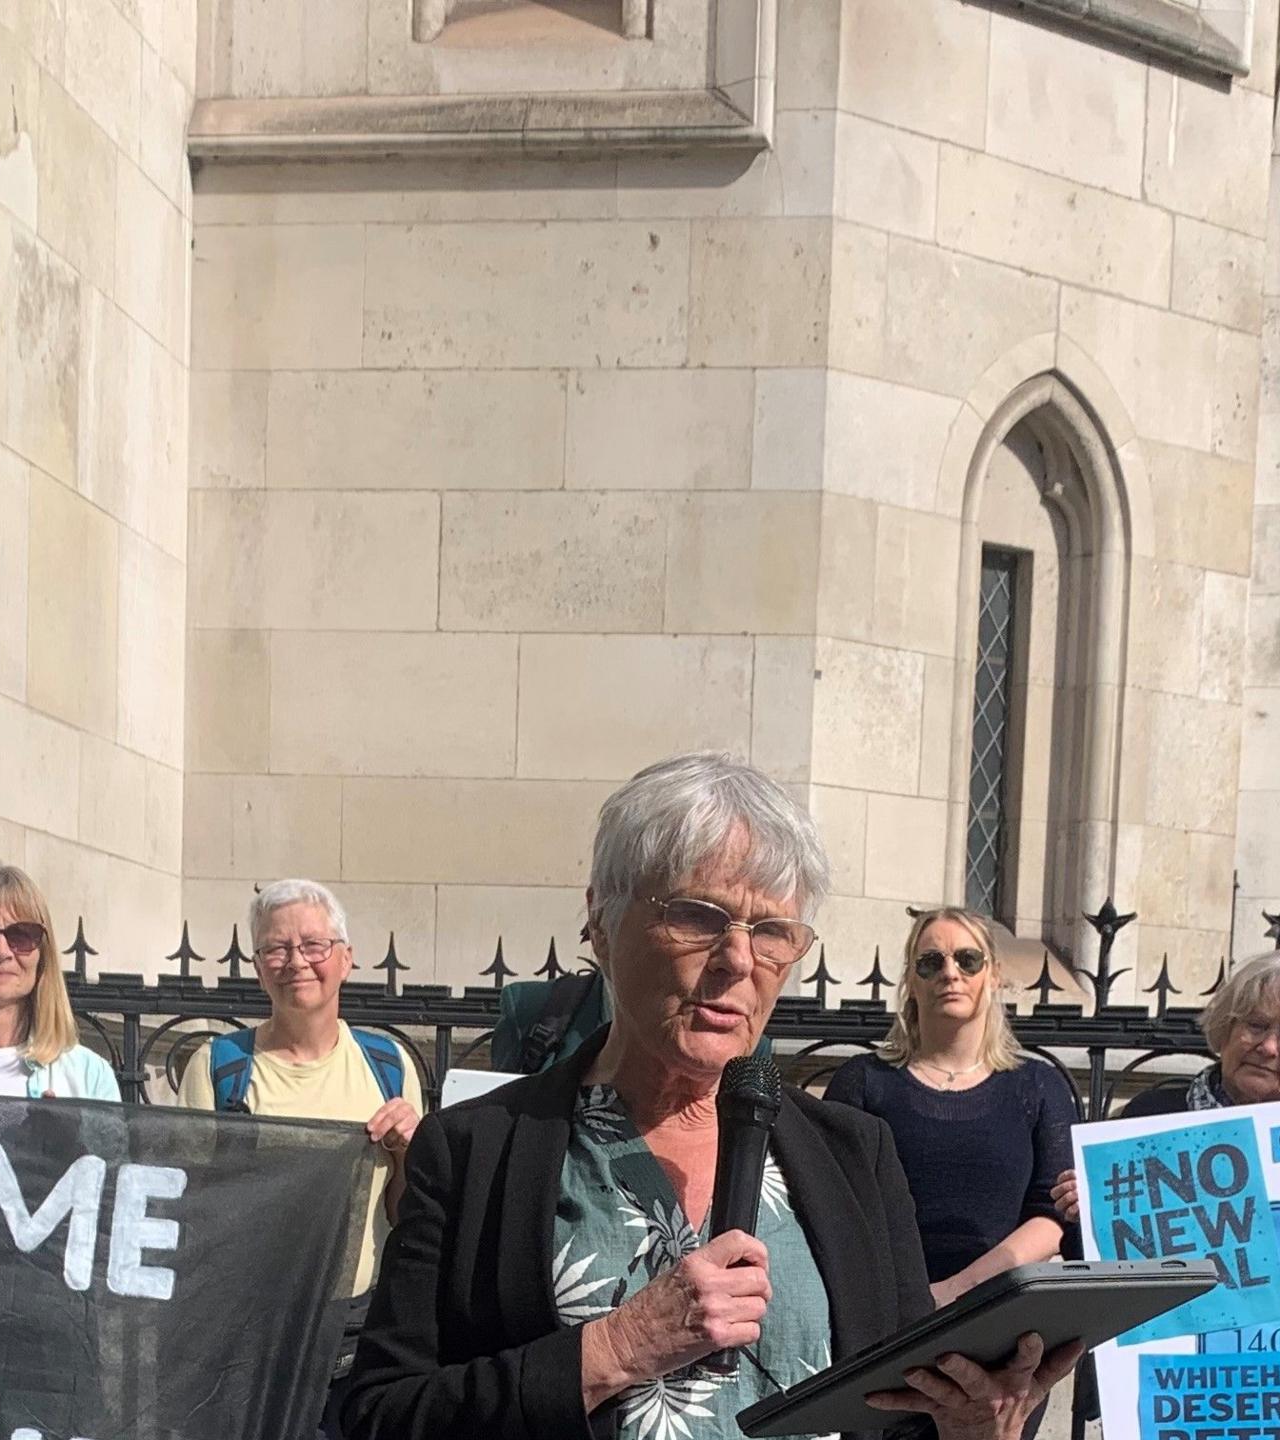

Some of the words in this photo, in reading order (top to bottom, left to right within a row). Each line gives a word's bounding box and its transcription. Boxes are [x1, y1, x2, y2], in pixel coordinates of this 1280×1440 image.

[1104, 1143, 1250, 1215] #NO
[1111, 1196, 1257, 1260] NEW
[1204, 1248, 1271, 1290] AL
